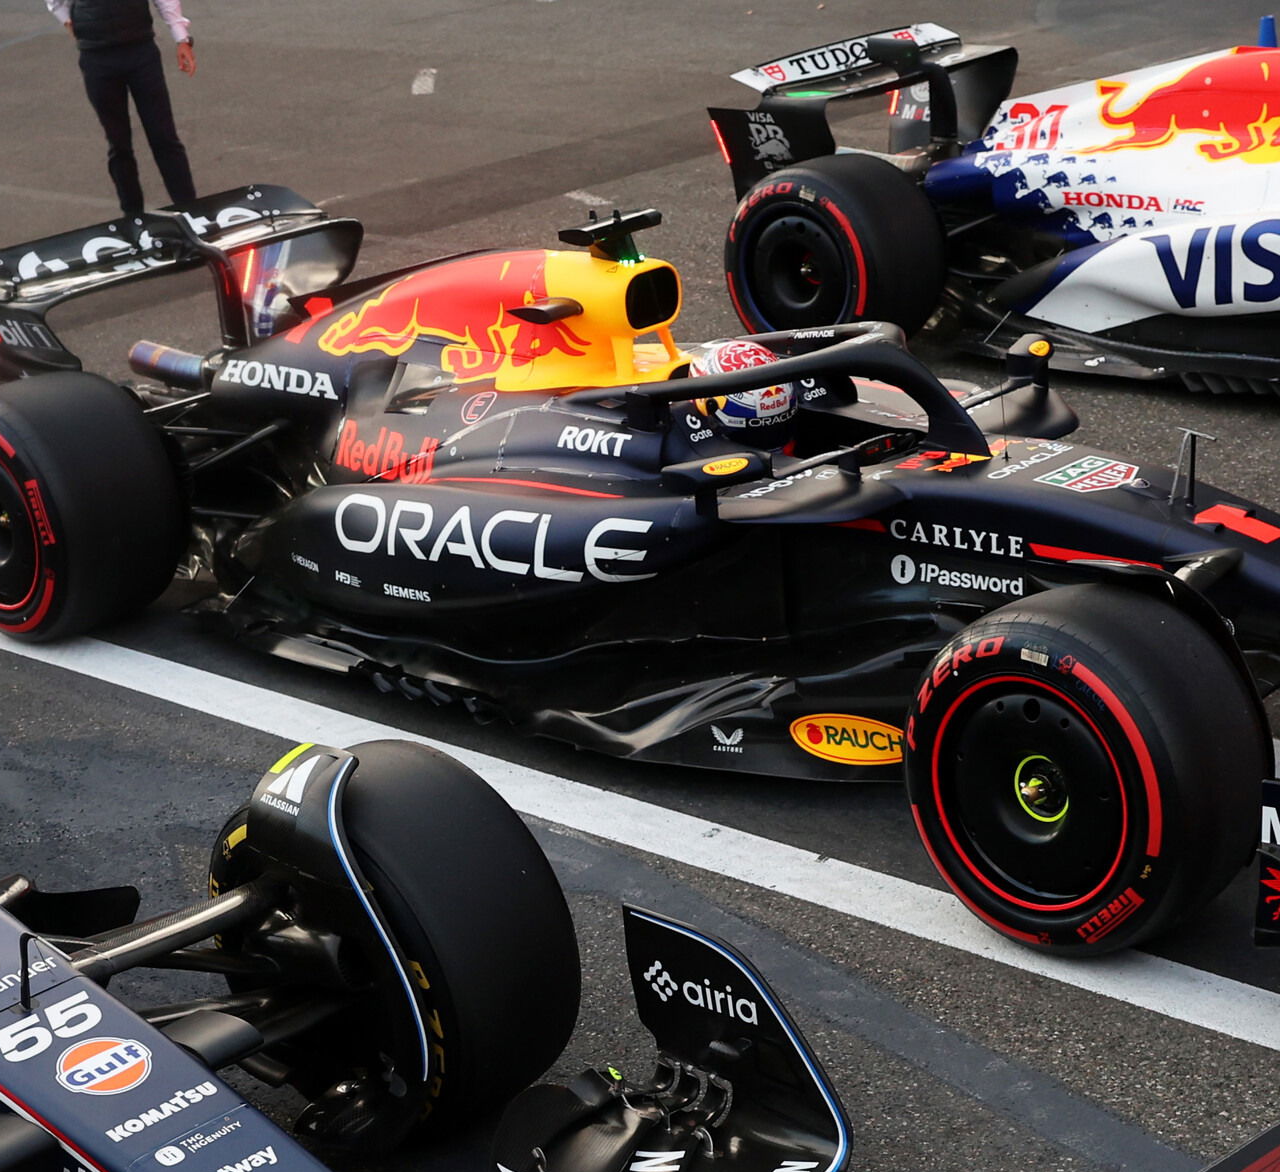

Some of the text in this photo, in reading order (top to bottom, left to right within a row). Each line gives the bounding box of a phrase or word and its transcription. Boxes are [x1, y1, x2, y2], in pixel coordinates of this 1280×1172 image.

[789, 42, 869, 76] TUDO
[747, 112, 775, 124] VISA
[1061, 191, 1163, 213] HONDA
[222, 359, 340, 401] HONDA
[803, 385, 827, 401] Gate
[748, 406, 798, 428] ORACLE
[760, 397, 789, 411] Red Bull
[558, 426, 632, 457] ROKT
[690, 427, 713, 443] Gate
[336, 420, 439, 484] Red Bull
[715, 459, 746, 471] RAUCH
[987, 444, 1075, 480] ORACLE
[1047, 459, 1103, 484] TAG
[1071, 463, 1130, 491] HEUER
[335, 493, 658, 584] ORACLE
[890, 519, 1024, 558] CARLYLE
[297, 555, 320, 573] HEXAGON
[383, 583, 431, 602] SIEMENS
[919, 563, 1024, 596] 1Password
[917, 636, 1005, 714] ZERO
[713, 745, 743, 754] CASTORE
[824, 725, 904, 753] RAUCH
[260, 793, 300, 817] ATLASSIAN
[1076, 887, 1145, 944] PIRELLI
[682, 978, 759, 1026] airia
[66, 1044, 144, 1088] Gulf
[105, 1080, 219, 1143] KOMATSU
[180, 1133, 205, 1148] THG
